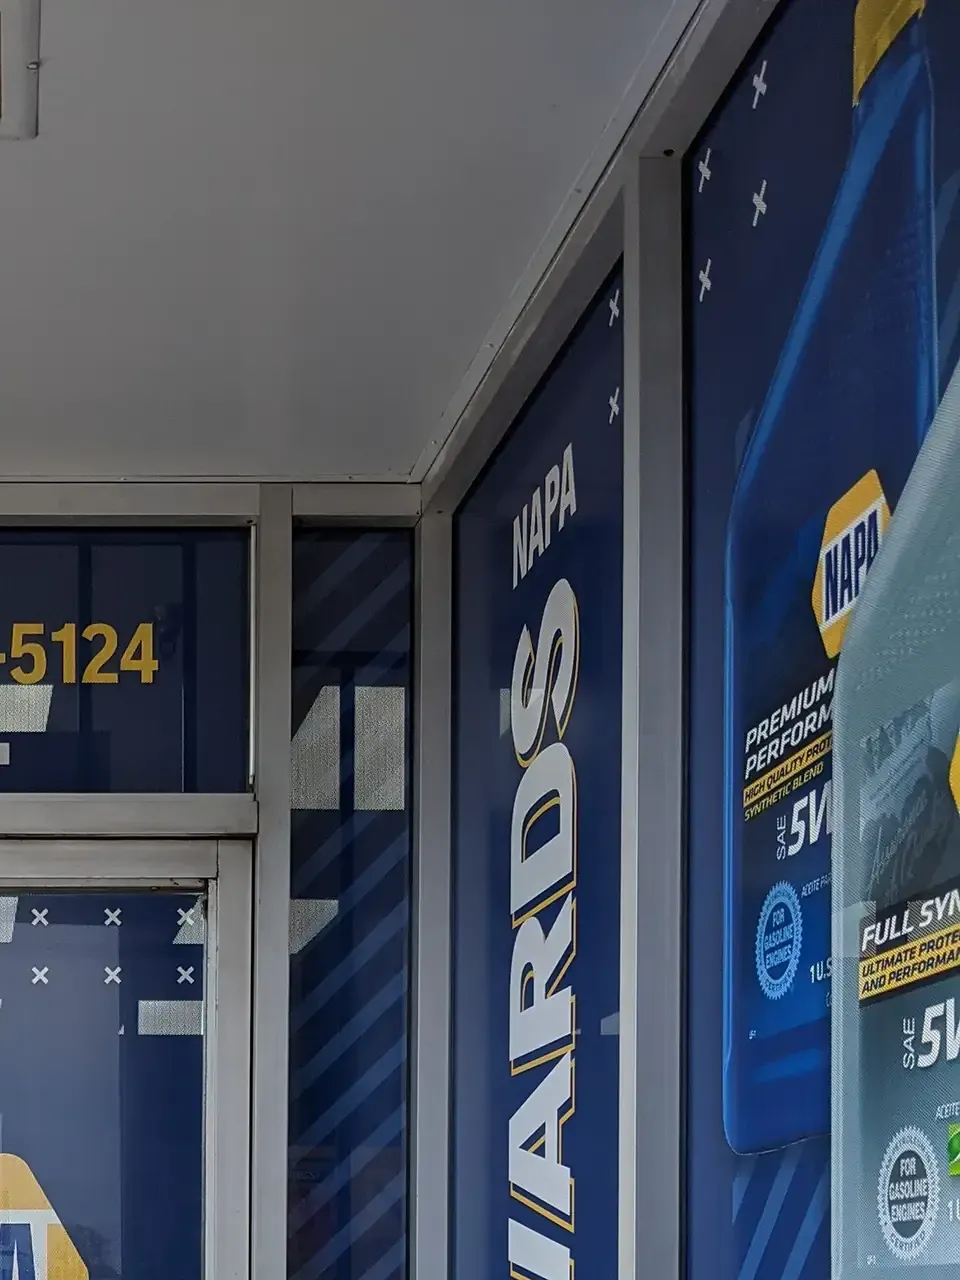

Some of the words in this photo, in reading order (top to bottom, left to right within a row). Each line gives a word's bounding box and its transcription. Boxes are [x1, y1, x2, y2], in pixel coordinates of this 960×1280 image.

[512, 442, 577, 590] NAPA
[745, 667, 835, 753] PREMIUM
[744, 780, 765, 803] HIGH
[766, 753, 805, 790] QUALITY
[744, 784, 791, 822] SYNTHETIC
[792, 761, 824, 791] BLEND
[776, 815, 787, 860] SAE
[772, 908, 786, 927] FOR
[861, 910, 914, 952] FULL
[764, 923, 794, 951] GASOLINE
[765, 944, 792, 969] ENGINES
[862, 946, 916, 978] ULTIMATE
[862, 974, 886, 994] AND
[902, 1016, 916, 1070] SAE
[899, 1157, 917, 1177] FOR
[889, 1178, 929, 1201] GASOLINE
[890, 1201, 925, 1223] ENGINES
